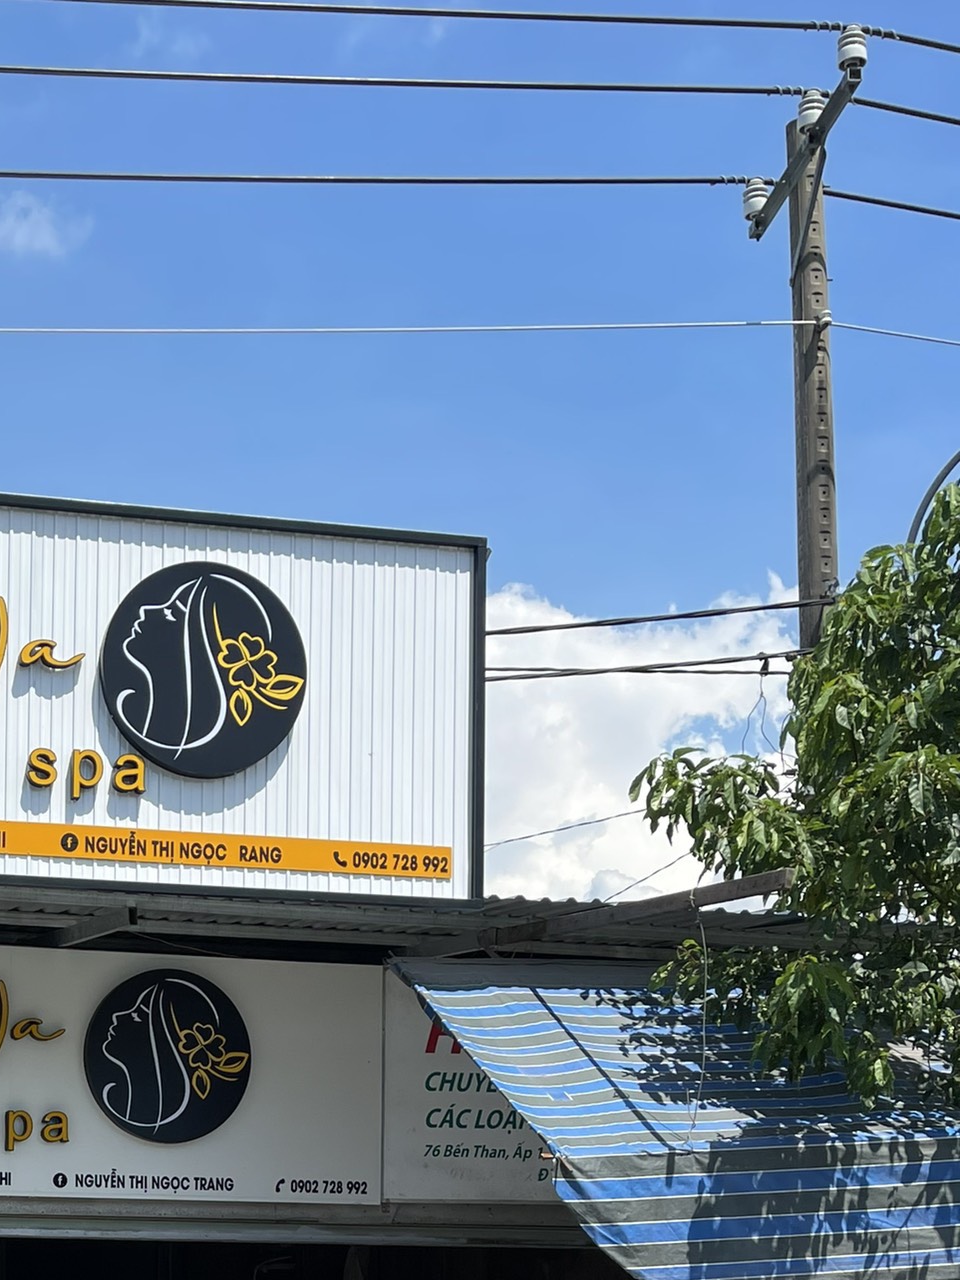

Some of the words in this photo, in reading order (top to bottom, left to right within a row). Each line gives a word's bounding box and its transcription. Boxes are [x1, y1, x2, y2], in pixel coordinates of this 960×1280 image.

[26, 747, 147, 801] spa
[84, 831, 147, 857] NGUYỄN
[152, 840, 175, 863] THỊ
[179, 842, 227, 865] NGỌC
[239, 845, 282, 864] RANG
[352, 851, 387, 870] 0902
[392, 854, 418, 872] 728
[422, 856, 449, 873] 992
[425, 1071, 497, 1092] CHUY
[426, 1103, 472, 1129] CÁC
[424, 1144, 441, 1157] 76
[443, 1142, 470, 1158] Bến
[473, 1144, 510, 1160] Than,
[513, 1141, 533, 1162] Ấp
[75, 1168, 125, 1189] NGUYỄN
[129, 1175, 148, 1193] THỊ
[151, 1176, 190, 1194] NGỌC
[194, 1176, 234, 1192] TRANG
[290, 1179, 319, 1193] 0902
[322, 1180, 343, 1194] 728
[346, 1181, 368, 1195] 992
